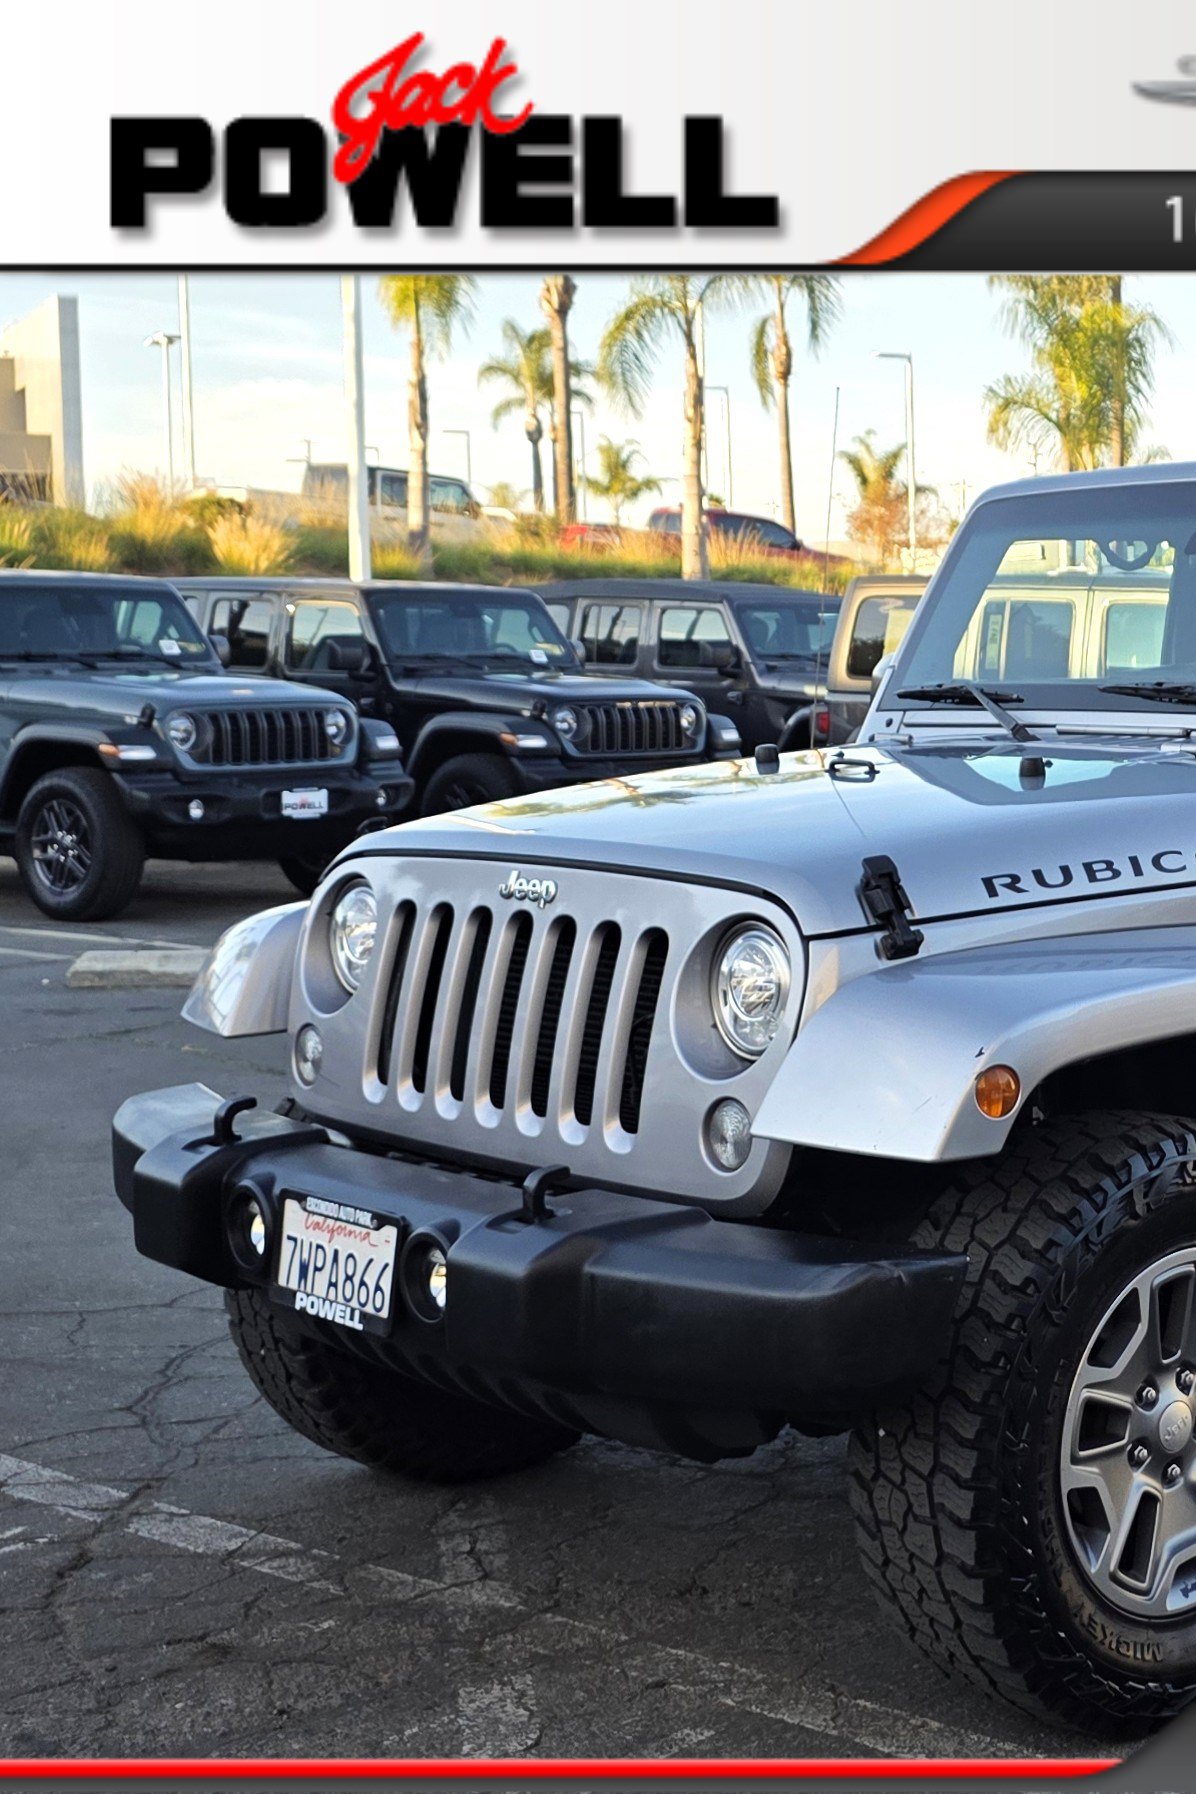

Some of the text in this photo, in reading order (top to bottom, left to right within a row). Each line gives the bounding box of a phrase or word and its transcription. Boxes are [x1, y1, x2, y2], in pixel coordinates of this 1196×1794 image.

[499, 869, 558, 909] Jeep
[304, 1213, 379, 1247] California
[286, 1234, 390, 1313] 7WPA866
[294, 1291, 364, 1331] POWELL
